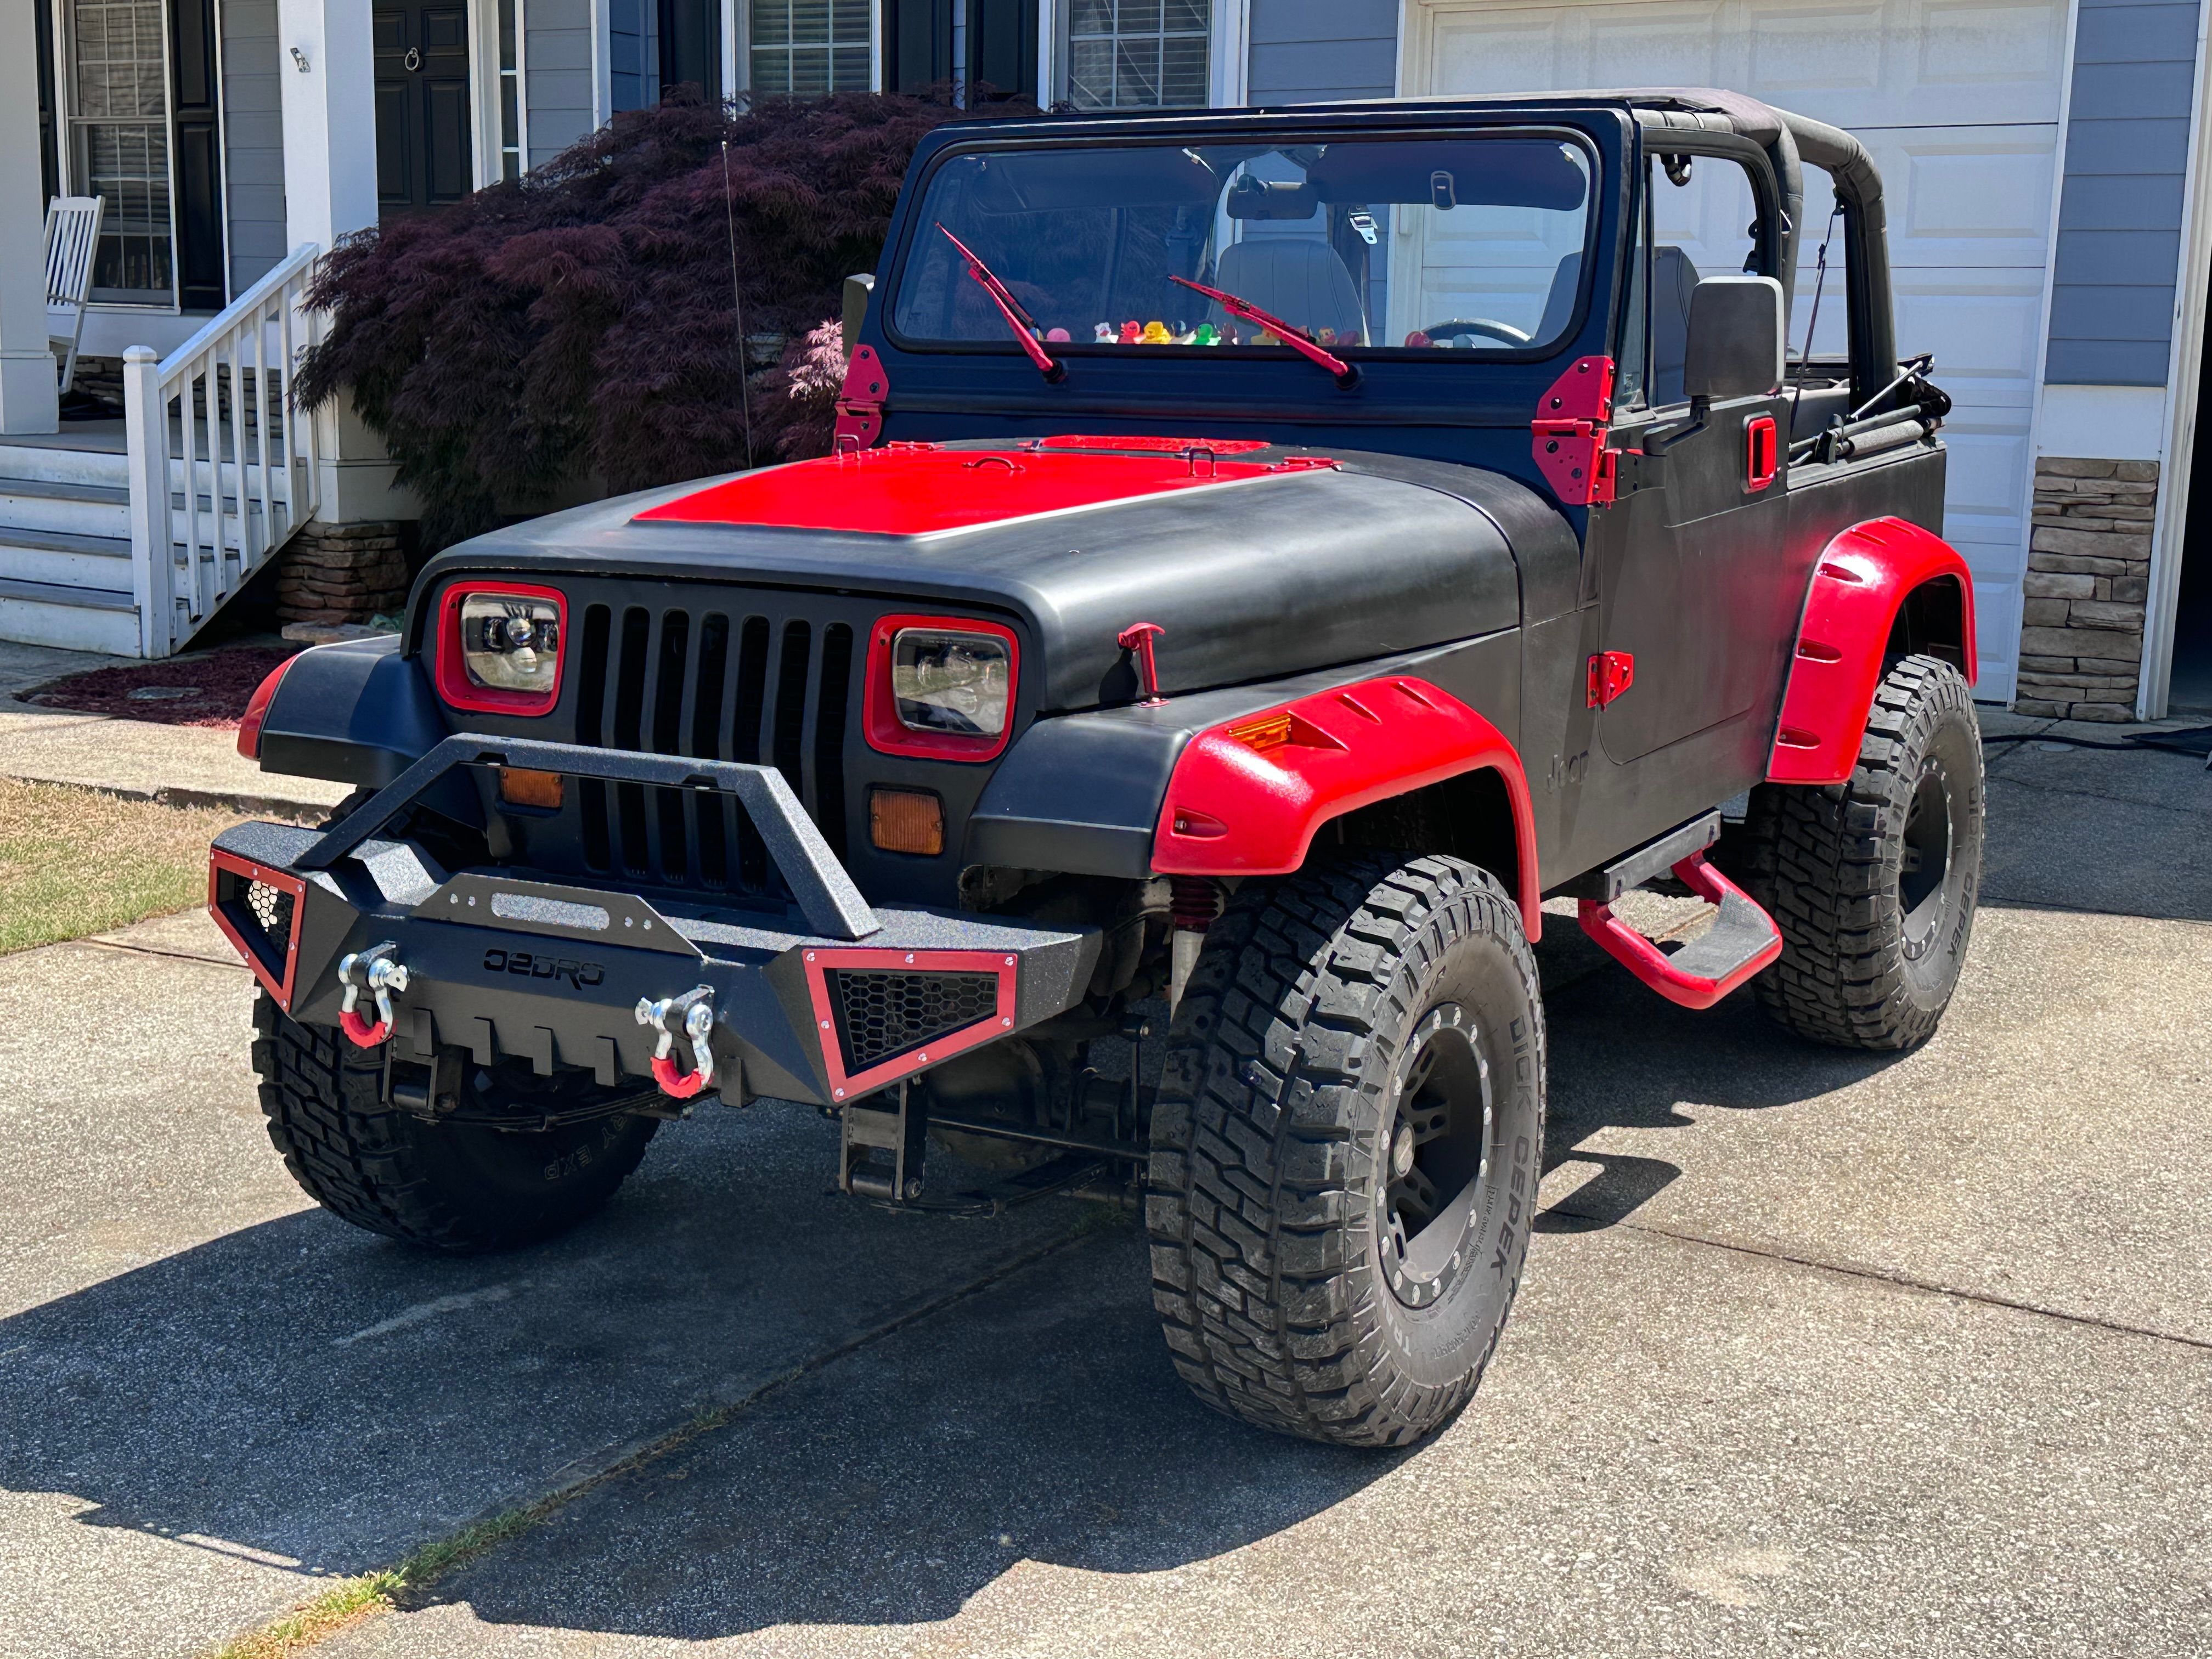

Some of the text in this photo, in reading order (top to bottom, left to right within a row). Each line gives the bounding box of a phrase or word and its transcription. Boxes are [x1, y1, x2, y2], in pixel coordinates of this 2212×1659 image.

[544, 1144, 593, 1181] EXP
[1490, 1017, 1533, 1282] DICK CEPEK
